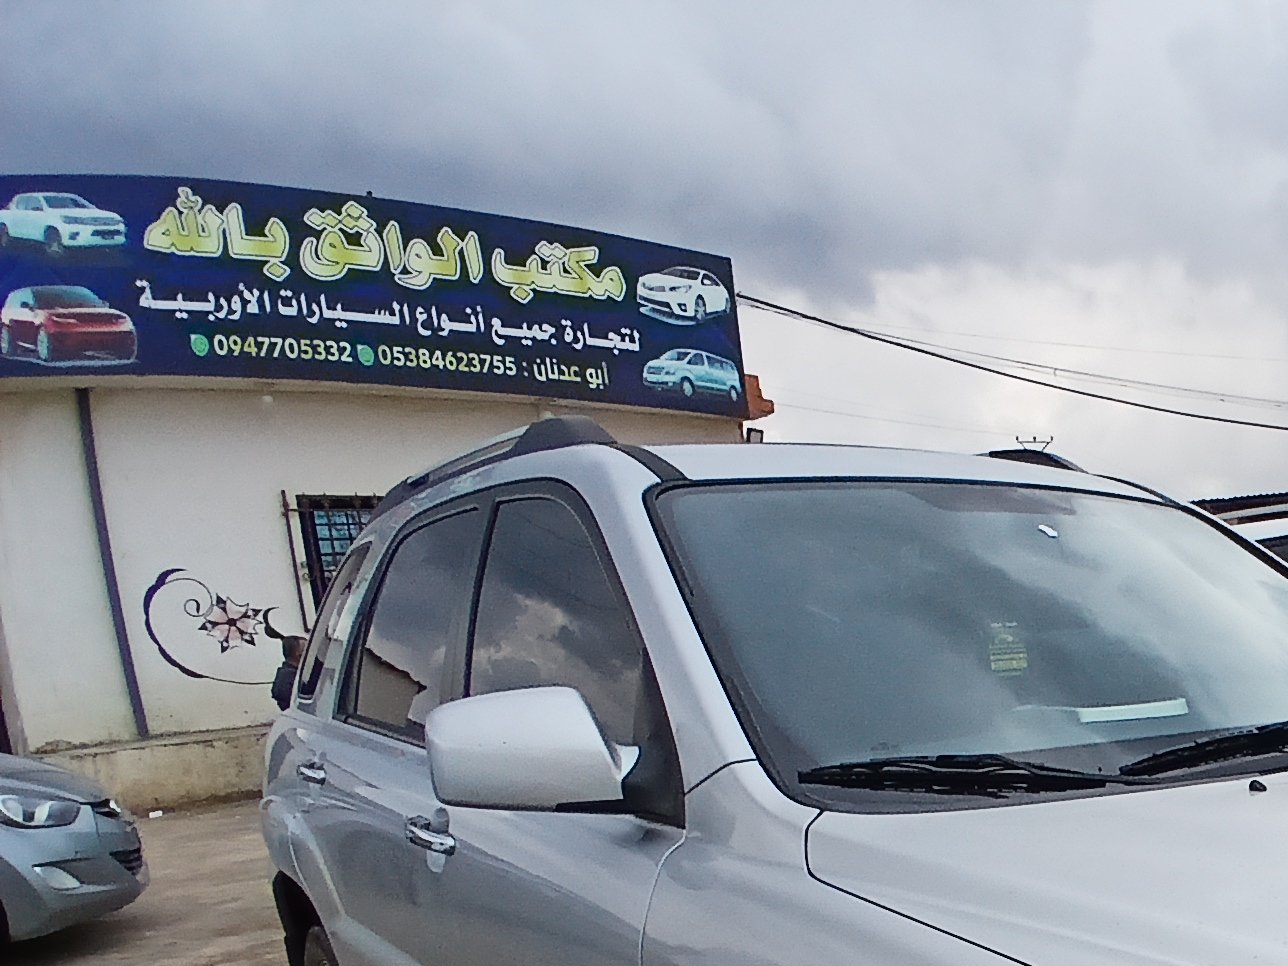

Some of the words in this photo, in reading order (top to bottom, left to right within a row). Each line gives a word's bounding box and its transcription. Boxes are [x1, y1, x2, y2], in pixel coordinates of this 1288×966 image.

[144, 186, 290, 282] بالله
[300, 201, 483, 290] الواثق
[491, 240, 627, 303] مكتب
[134, 279, 271, 321] الأوربية
[277, 288, 411, 330] السيارات
[415, 304, 485, 337] أنواع
[490, 315, 557, 346] جميع
[560, 318, 641, 355] لتجارة
[213, 334, 353, 363] 0947705332
[377, 344, 517, 376] 05384623755
[532, 356, 582, 383] عدنان
